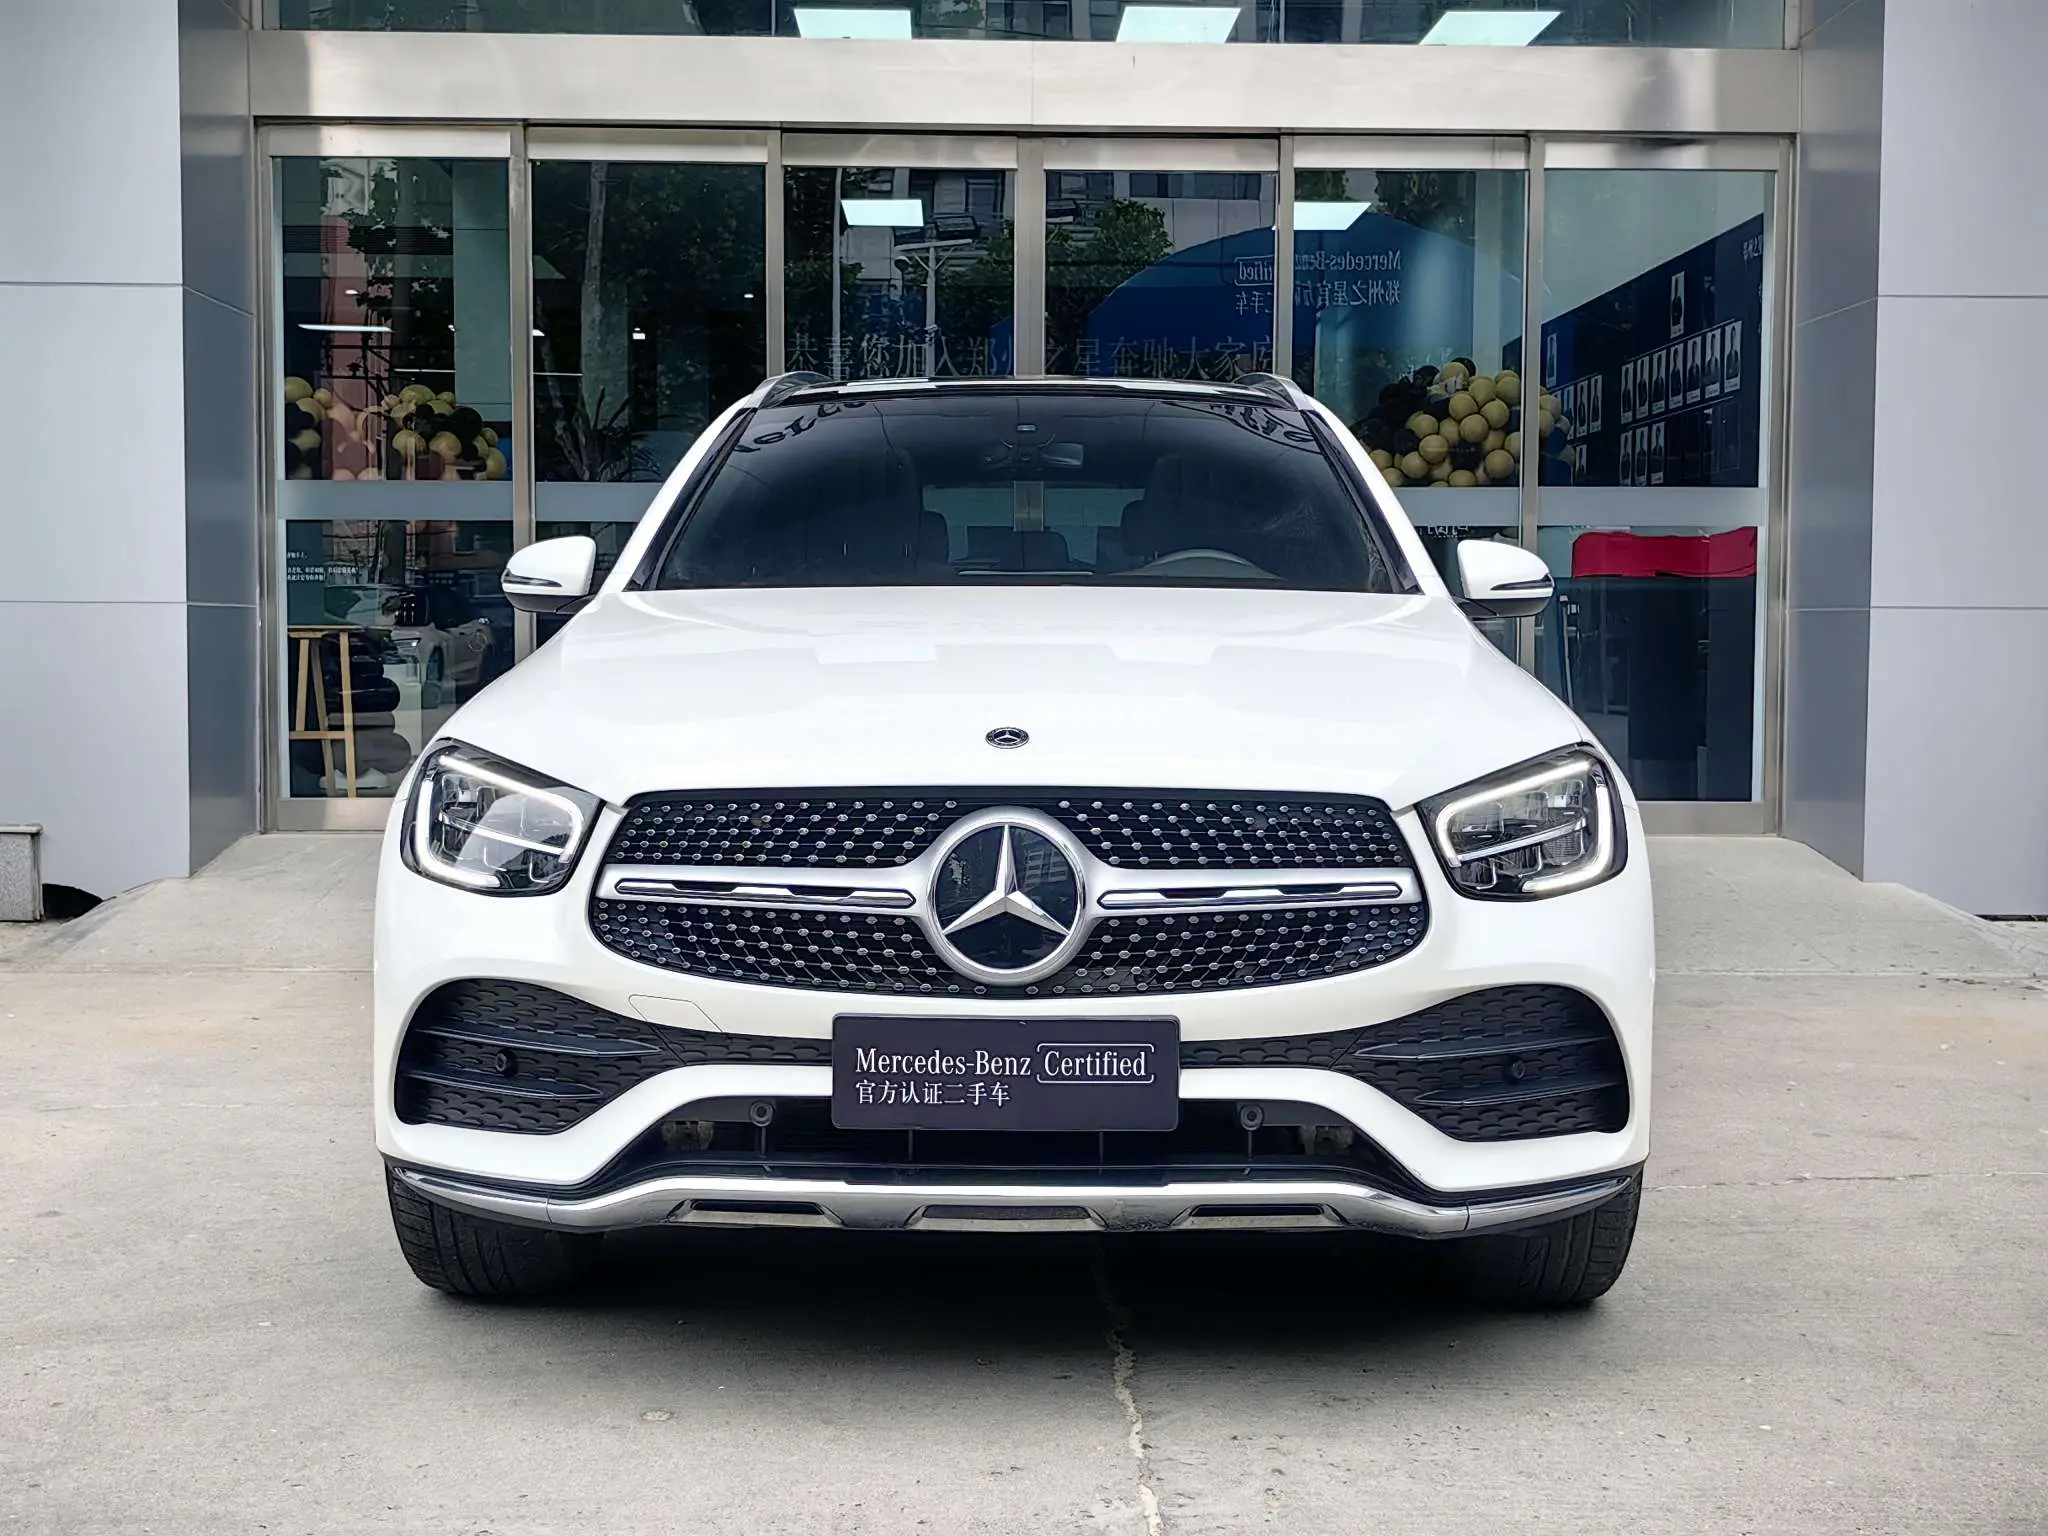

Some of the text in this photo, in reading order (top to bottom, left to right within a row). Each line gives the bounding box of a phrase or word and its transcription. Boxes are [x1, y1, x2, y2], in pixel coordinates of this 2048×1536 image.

[855, 1047, 1147, 1077] Mercedes-Benz Certified
[855, 1080, 1011, 1107] 官方认证二手车
